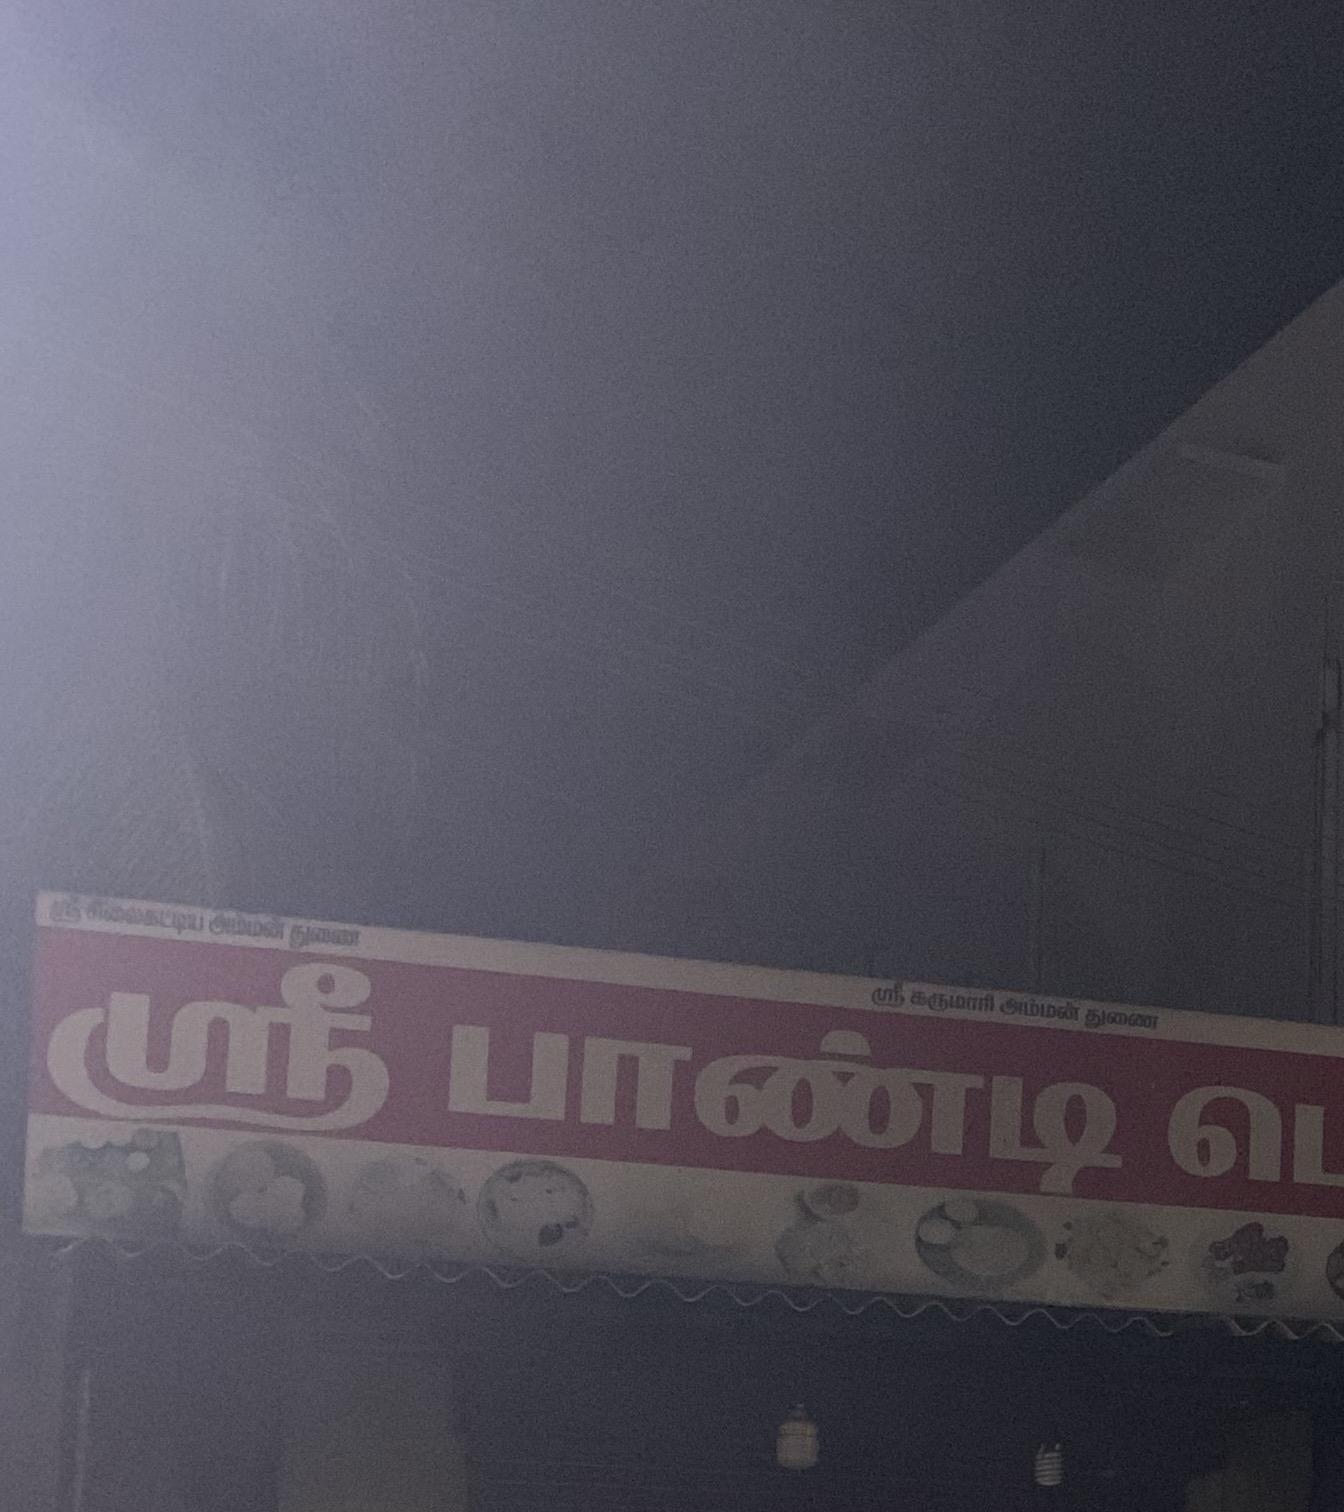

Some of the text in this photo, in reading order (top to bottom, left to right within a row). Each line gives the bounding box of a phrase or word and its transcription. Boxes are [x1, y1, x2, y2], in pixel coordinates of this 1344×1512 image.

[910, 989, 995, 1012] கருமாரி
[999, 996, 1080, 1021] அம்மன்
[1084, 1009, 1159, 1030] துணை
[447, 1023, 1123, 1195] பாண்டி
